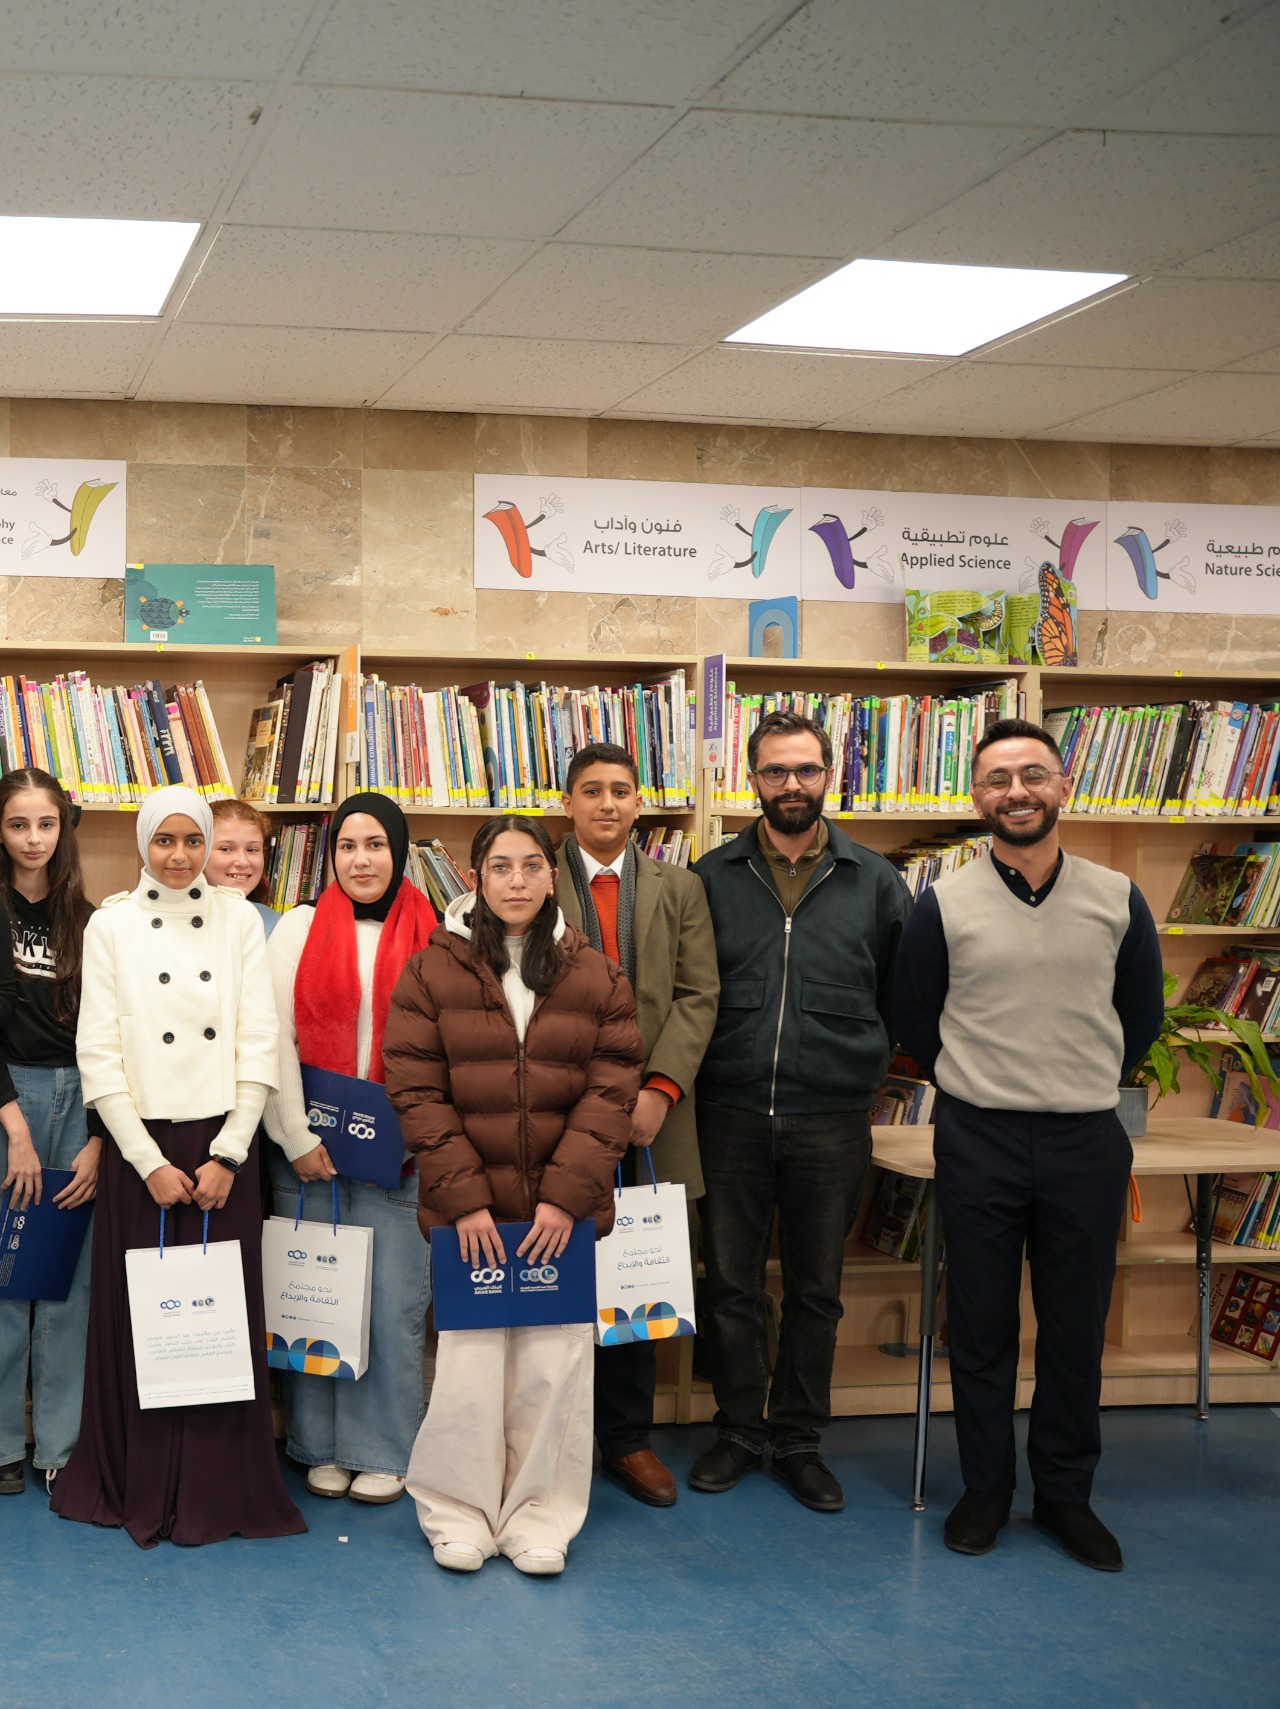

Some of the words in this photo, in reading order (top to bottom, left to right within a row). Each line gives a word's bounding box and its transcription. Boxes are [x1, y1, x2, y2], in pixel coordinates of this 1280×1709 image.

[594, 514, 637, 534] وآداب
[641, 518, 682, 535] فنون
[902, 526, 965, 549] تطبيقية
[968, 532, 1009, 548] علوم
[583, 540, 620, 555] Arts/
[624, 541, 697, 558] Literature
[1206, 539, 1264, 559] طبيعية
[900, 552, 956, 570] Applied
[959, 553, 1011, 570] Science
[1205, 562, 1252, 576] Nature
[1256, 563, 1280, 577] Scie
[622, 1246, 647, 1258] مجتمع
[647, 1245, 663, 1255] نحو
[645, 1256, 670, 1267] الثقافة
[288, 1281, 316, 1293] مجتمع
[317, 1285, 332, 1294] نحو
[310, 1294, 338, 1306] الثقافة
